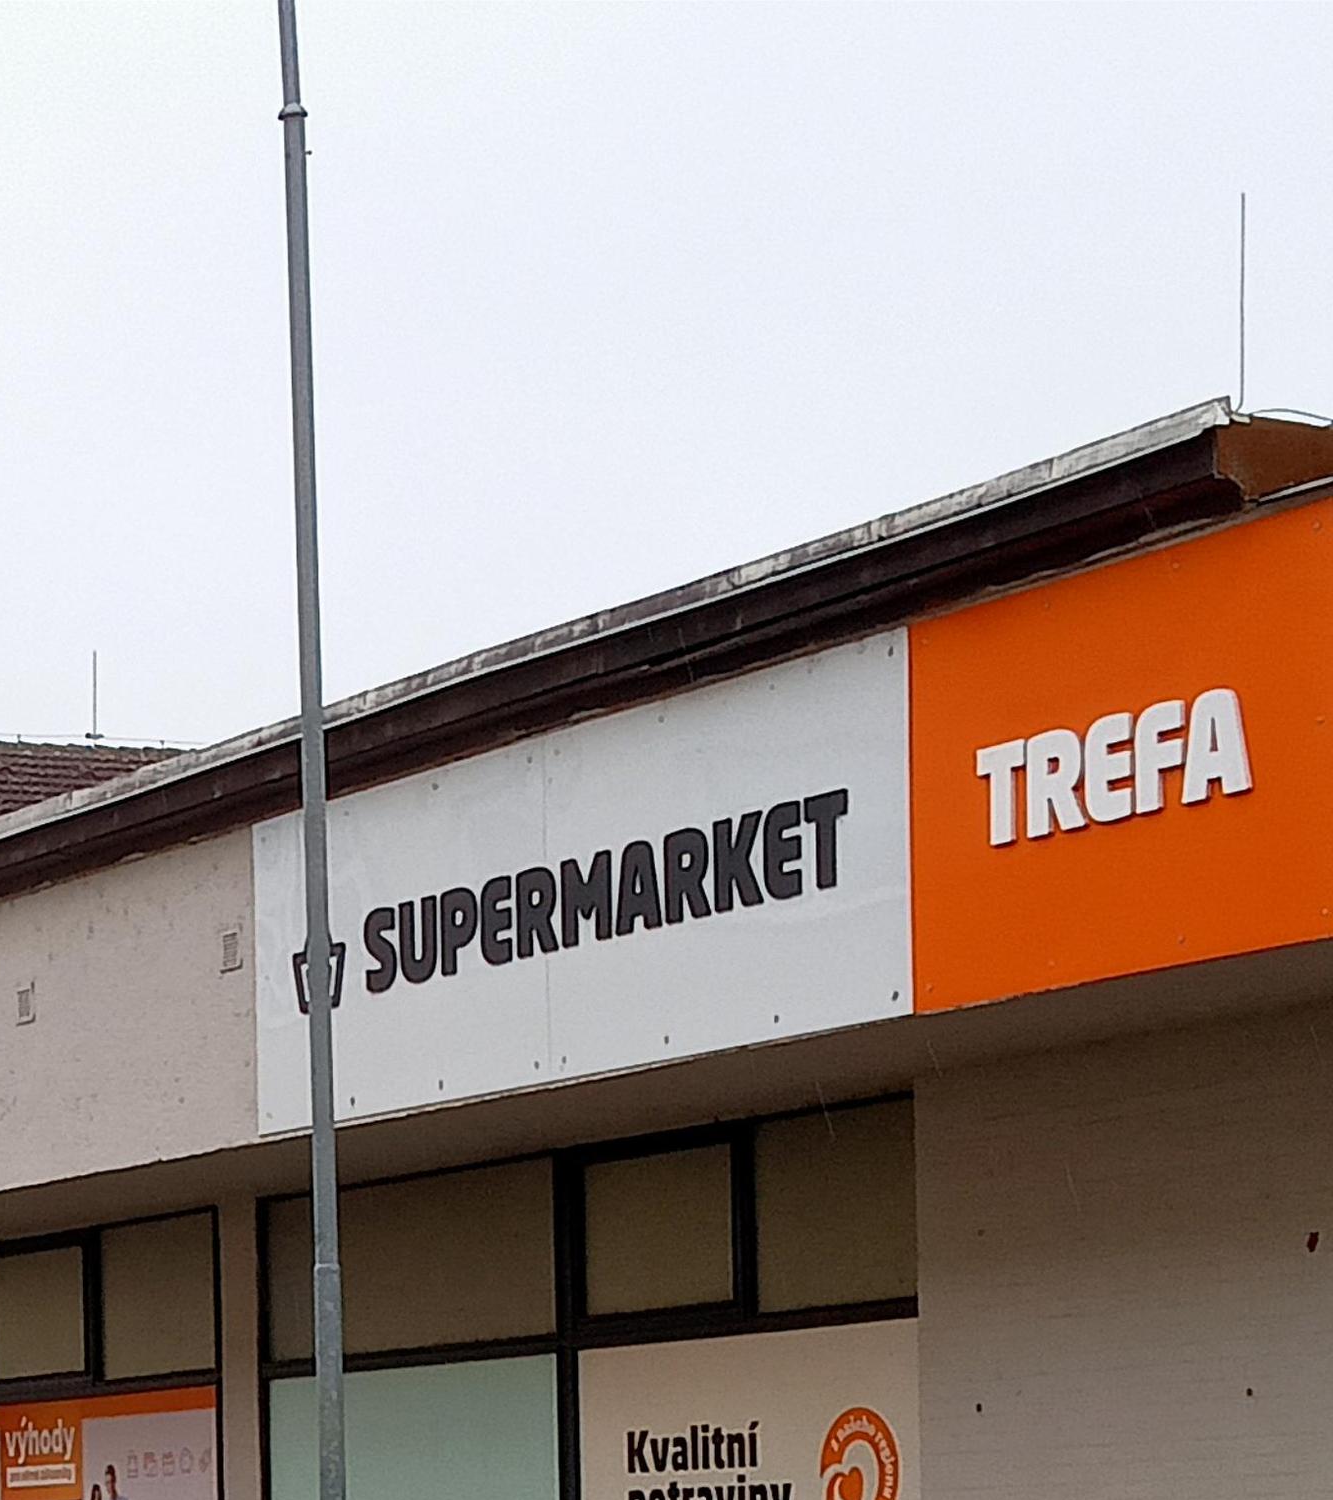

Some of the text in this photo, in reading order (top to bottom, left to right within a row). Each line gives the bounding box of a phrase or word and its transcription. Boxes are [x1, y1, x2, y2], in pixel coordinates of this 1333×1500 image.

[975, 687, 1253, 848] TREFA
[364, 788, 850, 994] SUPERMARKET
[4, 1416, 76, 1465] výhody
[627, 1421, 759, 1474] Kvalitní
